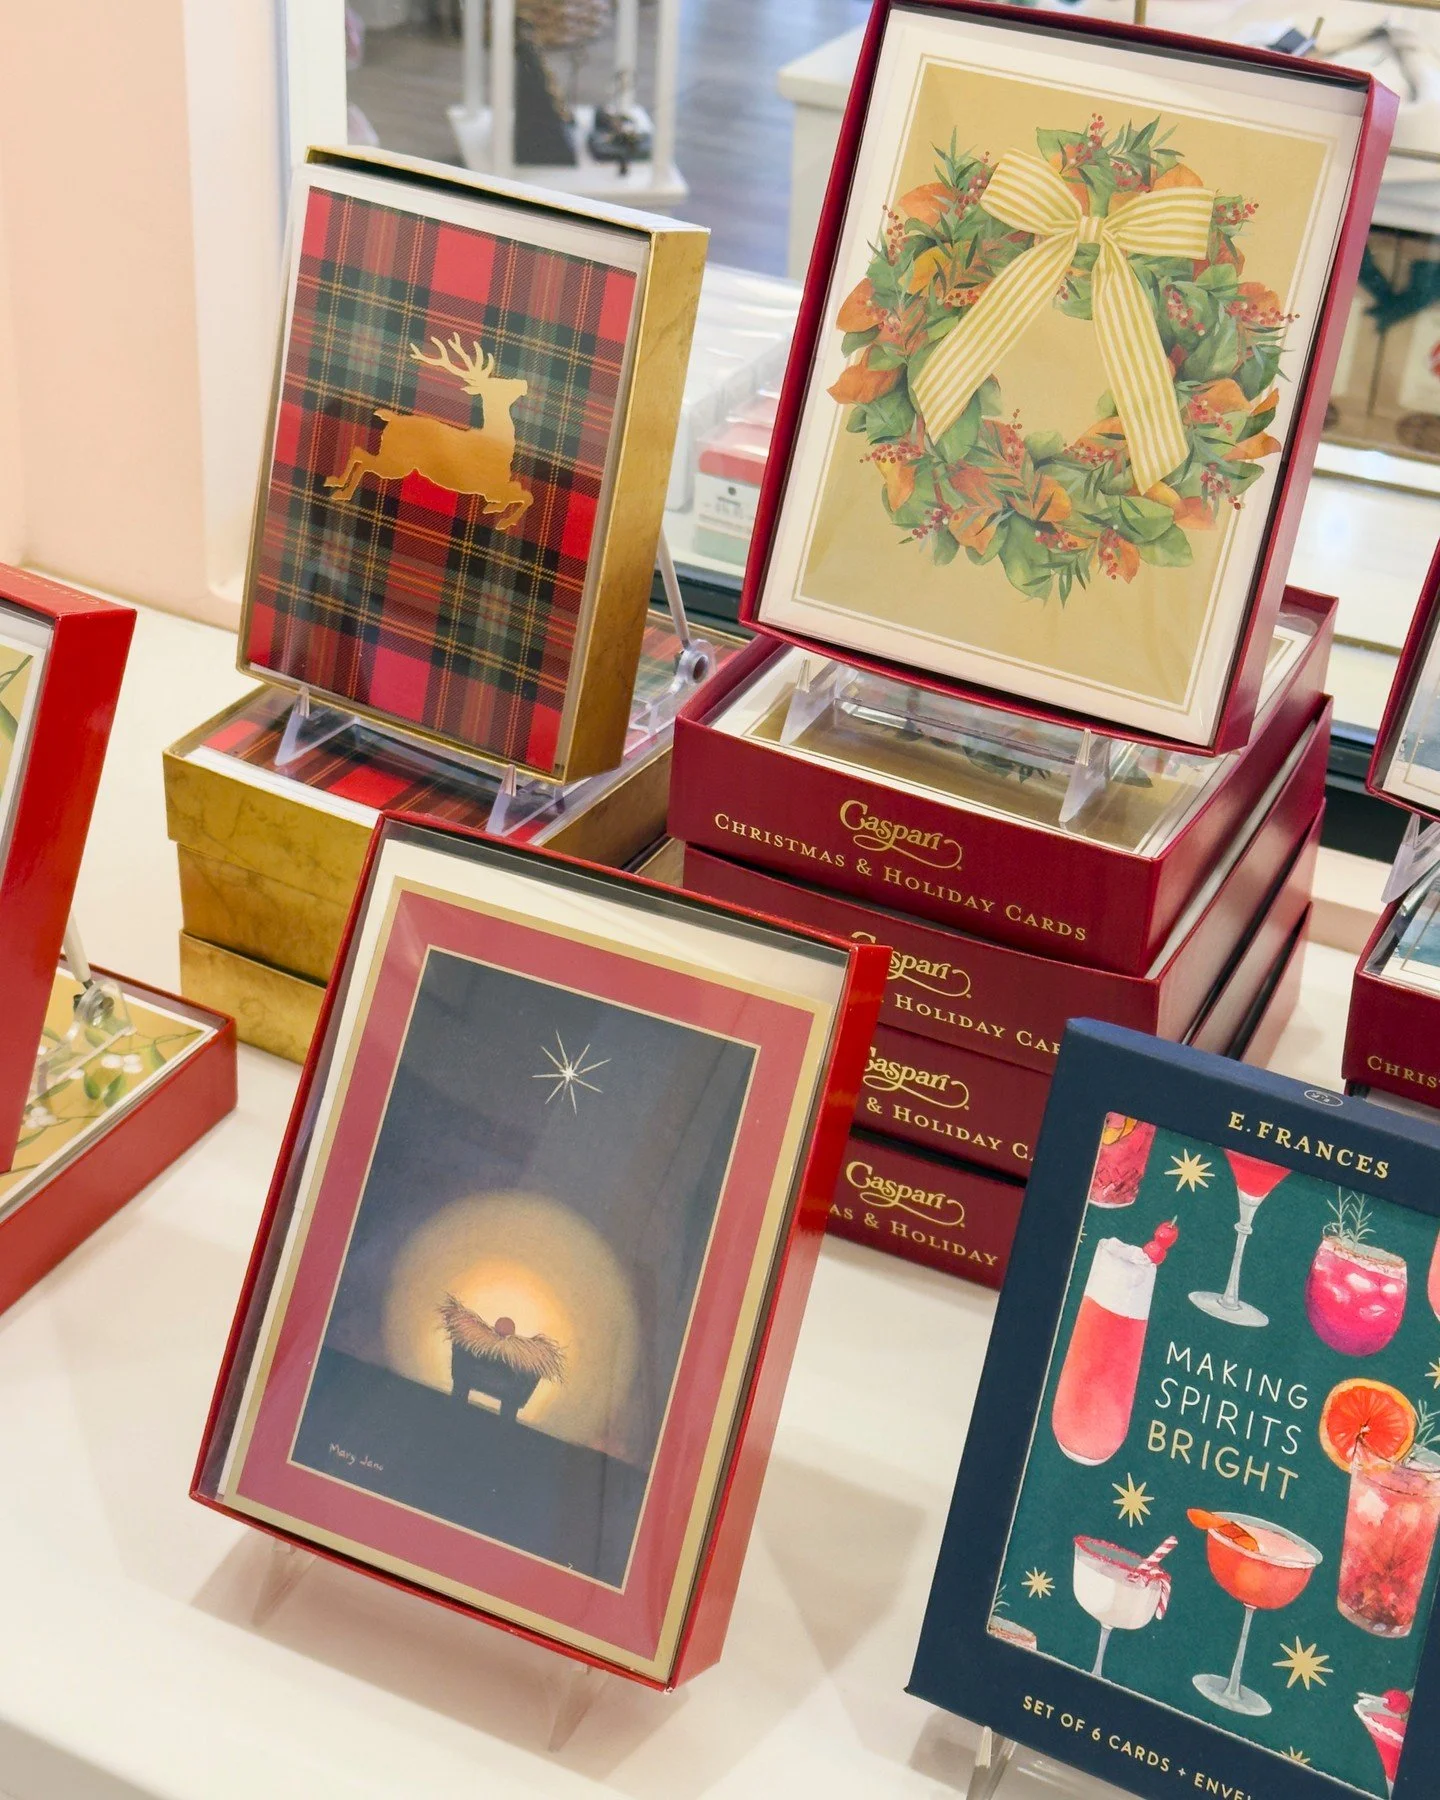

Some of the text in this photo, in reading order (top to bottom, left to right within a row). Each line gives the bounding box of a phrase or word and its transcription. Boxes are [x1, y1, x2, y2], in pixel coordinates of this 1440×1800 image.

[840, 800, 962, 869] Caspari
[714, 813, 1087, 941] CHRISTMAS & HOLIDAY CARDS
[894, 992, 1006, 1039] HOLIDAY
[1366, 1055, 1440, 1089] CHRIS
[866, 1096, 1002, 1151] & HOLIDAY
[846, 1161, 966, 1227] Caspari
[864, 1212, 880, 1229] &
[890, 1220, 998, 1267] HOLIDAY
[1166, 1341, 1308, 1409] MAKING
[1155, 1377, 1302, 1455] SPIRITS
[328, 1442, 356, 1466] Mary
[1147, 1419, 1299, 1500] BRIGHT
[1023, 1695, 1055, 1719] SET
[1060, 1712, 1085, 1733] OF
[1091, 1727, 1101, 1741] 6
[1108, 1735, 1171, 1772] CARDS
